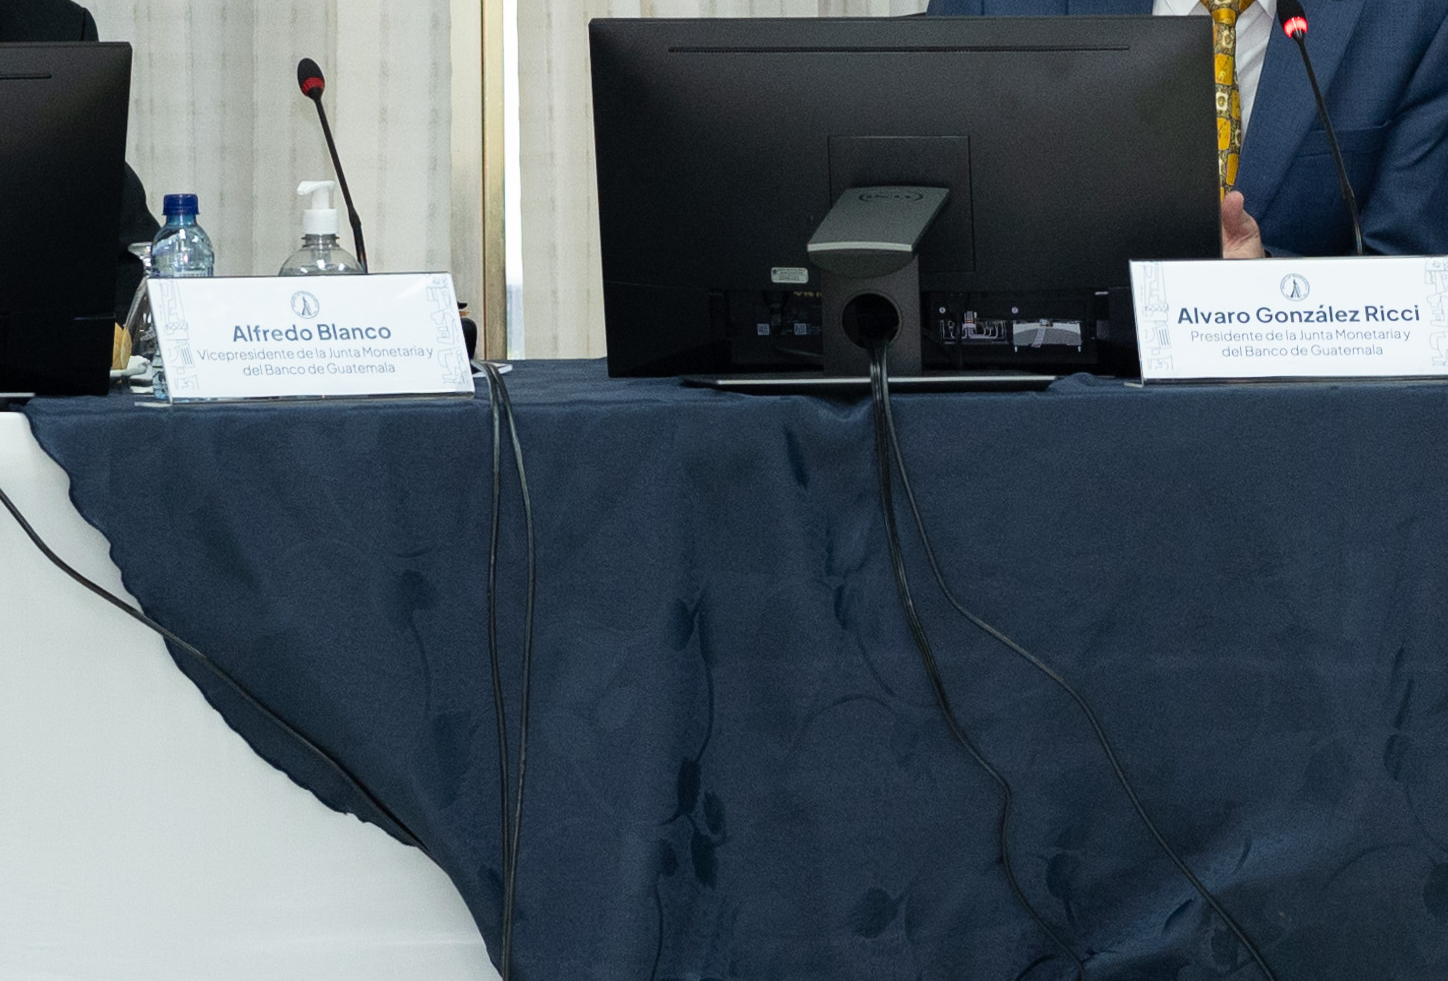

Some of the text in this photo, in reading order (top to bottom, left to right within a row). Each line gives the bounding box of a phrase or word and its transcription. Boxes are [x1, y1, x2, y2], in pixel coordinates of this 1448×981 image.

[1177, 304, 1420, 325] Alvaro González Ricci
[232, 323, 392, 343] Alfredo Blanco
[1190, 328, 1411, 342] Presidente de la Junta Monetaria y
[196, 345, 434, 362] Vicepresidente de la Junta Monetaria y
[1221, 344, 1384, 357] del Banco de Guatemala
[242, 361, 396, 376] del Banco de Guatemala
